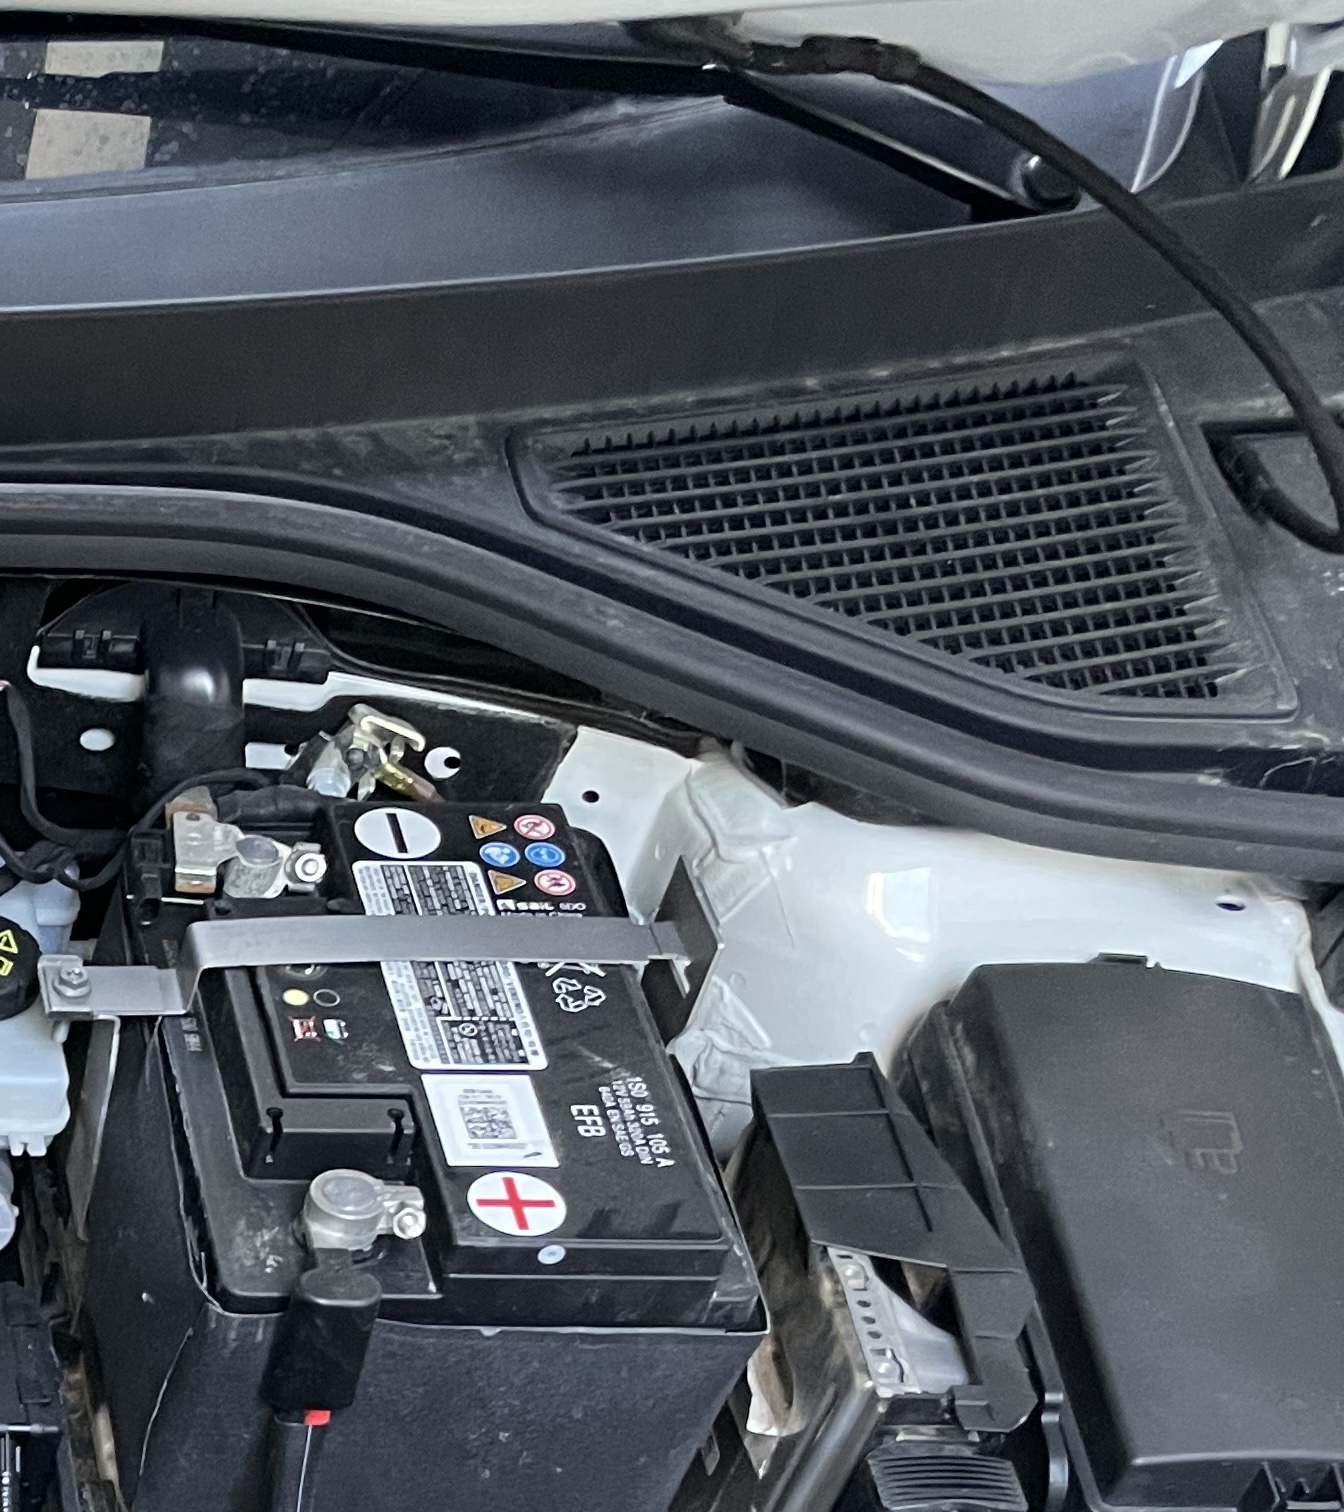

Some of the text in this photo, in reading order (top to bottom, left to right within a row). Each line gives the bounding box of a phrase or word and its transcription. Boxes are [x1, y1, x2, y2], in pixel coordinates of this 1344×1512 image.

[570, 1104, 607, 1137] EFB
[635, 1104, 662, 1126] 915
[646, 1133, 672, 1154] 105
[655, 1157, 676, 1168] A
